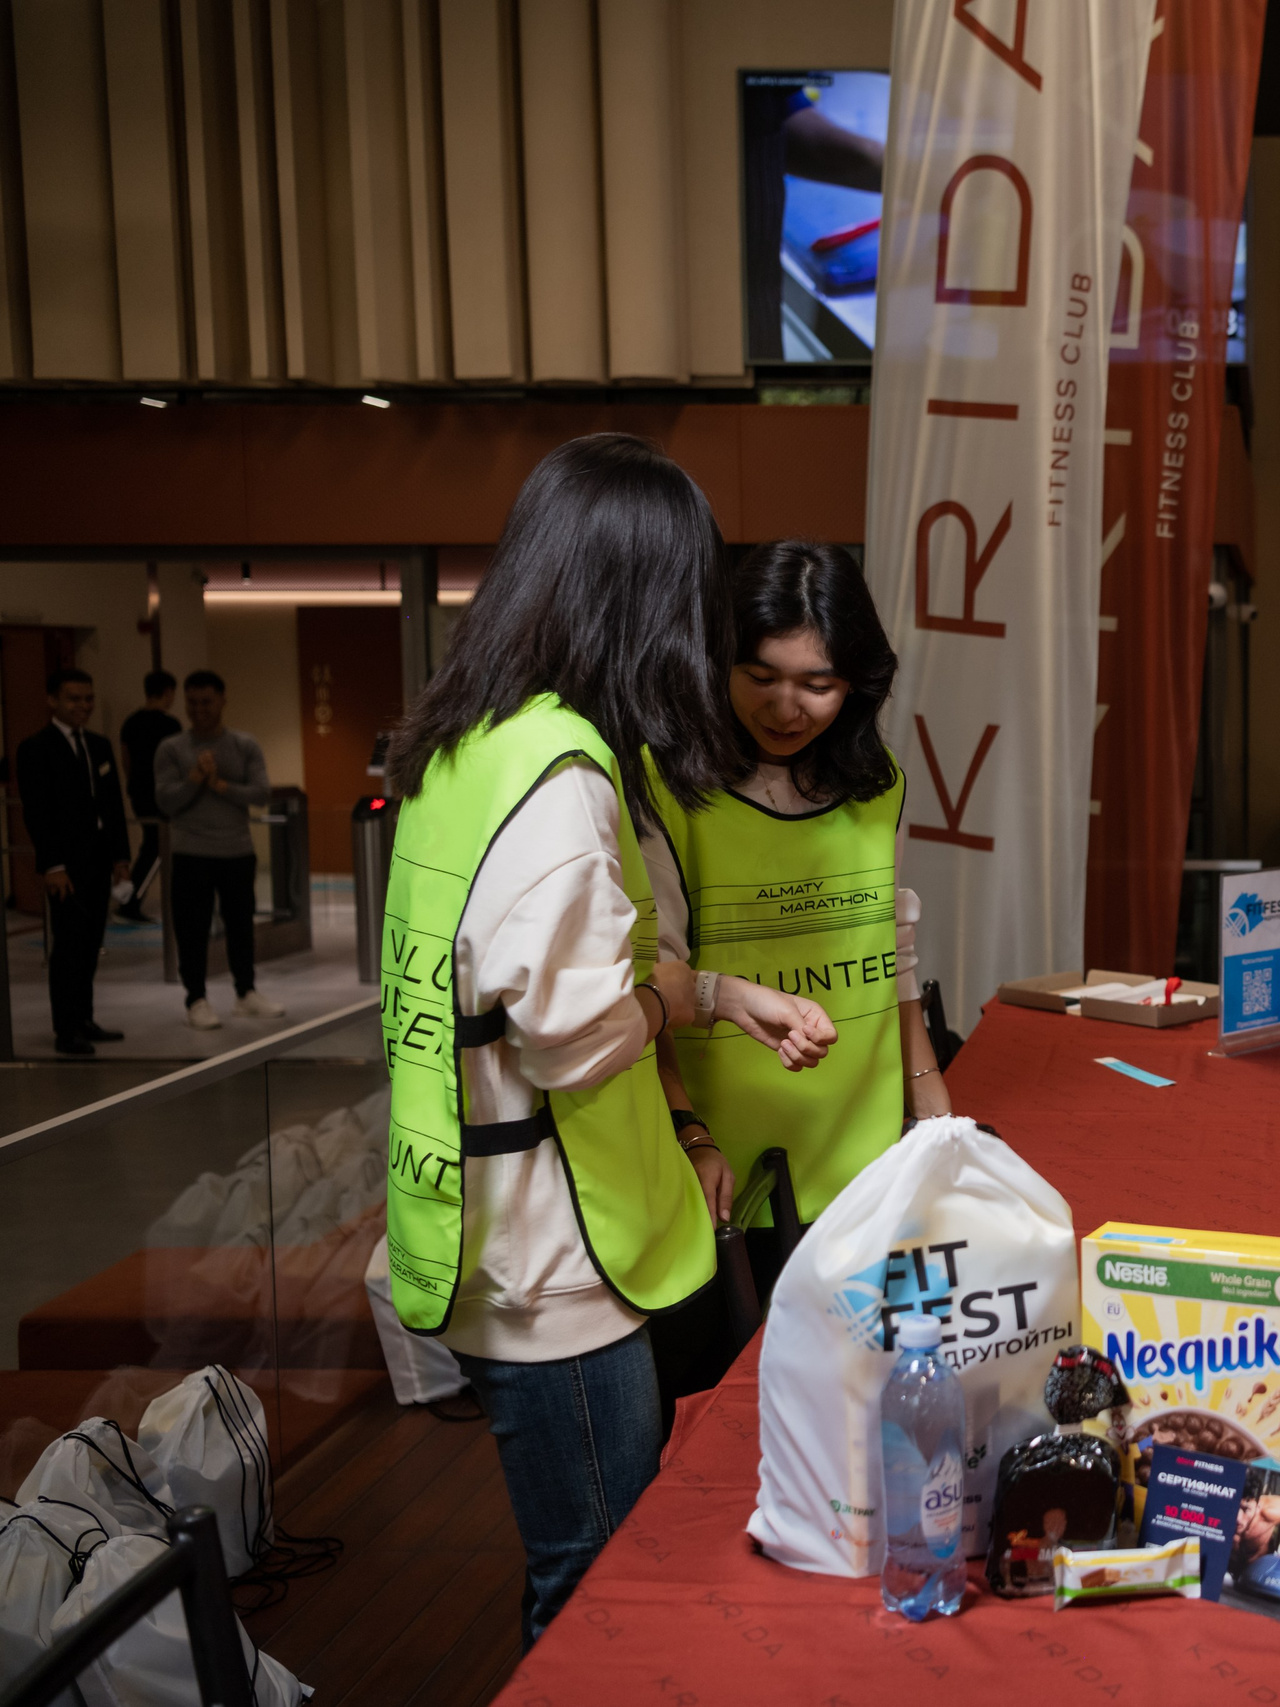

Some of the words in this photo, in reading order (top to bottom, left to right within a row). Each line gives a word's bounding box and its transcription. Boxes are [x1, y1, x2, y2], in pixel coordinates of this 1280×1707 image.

[1060, 272, 1093, 366] CLUB
[1171, 321, 1200, 402] CLUB
[908, 0, 1043, 853] KRIDA
[1047, 378, 1078, 528] FITNESS
[1156, 411, 1190, 540] FITNESS
[756, 881, 824, 900] ALMATY
[780, 891, 878, 915] MARATHON
[883, 1239, 969, 1299] FIT
[1210, 1271, 1242, 1286] Whole
[1243, 1275, 1272, 1289] Grain
[1107, 1304, 1121, 1316] EU
[944, 1321, 1073, 1371] ДРУГОЙТЫ
[1157, 1471, 1237, 1499] СЕРТИФИКАТ
[1164, 1505, 1179, 1519] 10
[1181, 1509, 1205, 1525] 000
[1017, 1626, 1123, 1700] KRIDA
[1188, 1642, 1279, 1705] KRID
